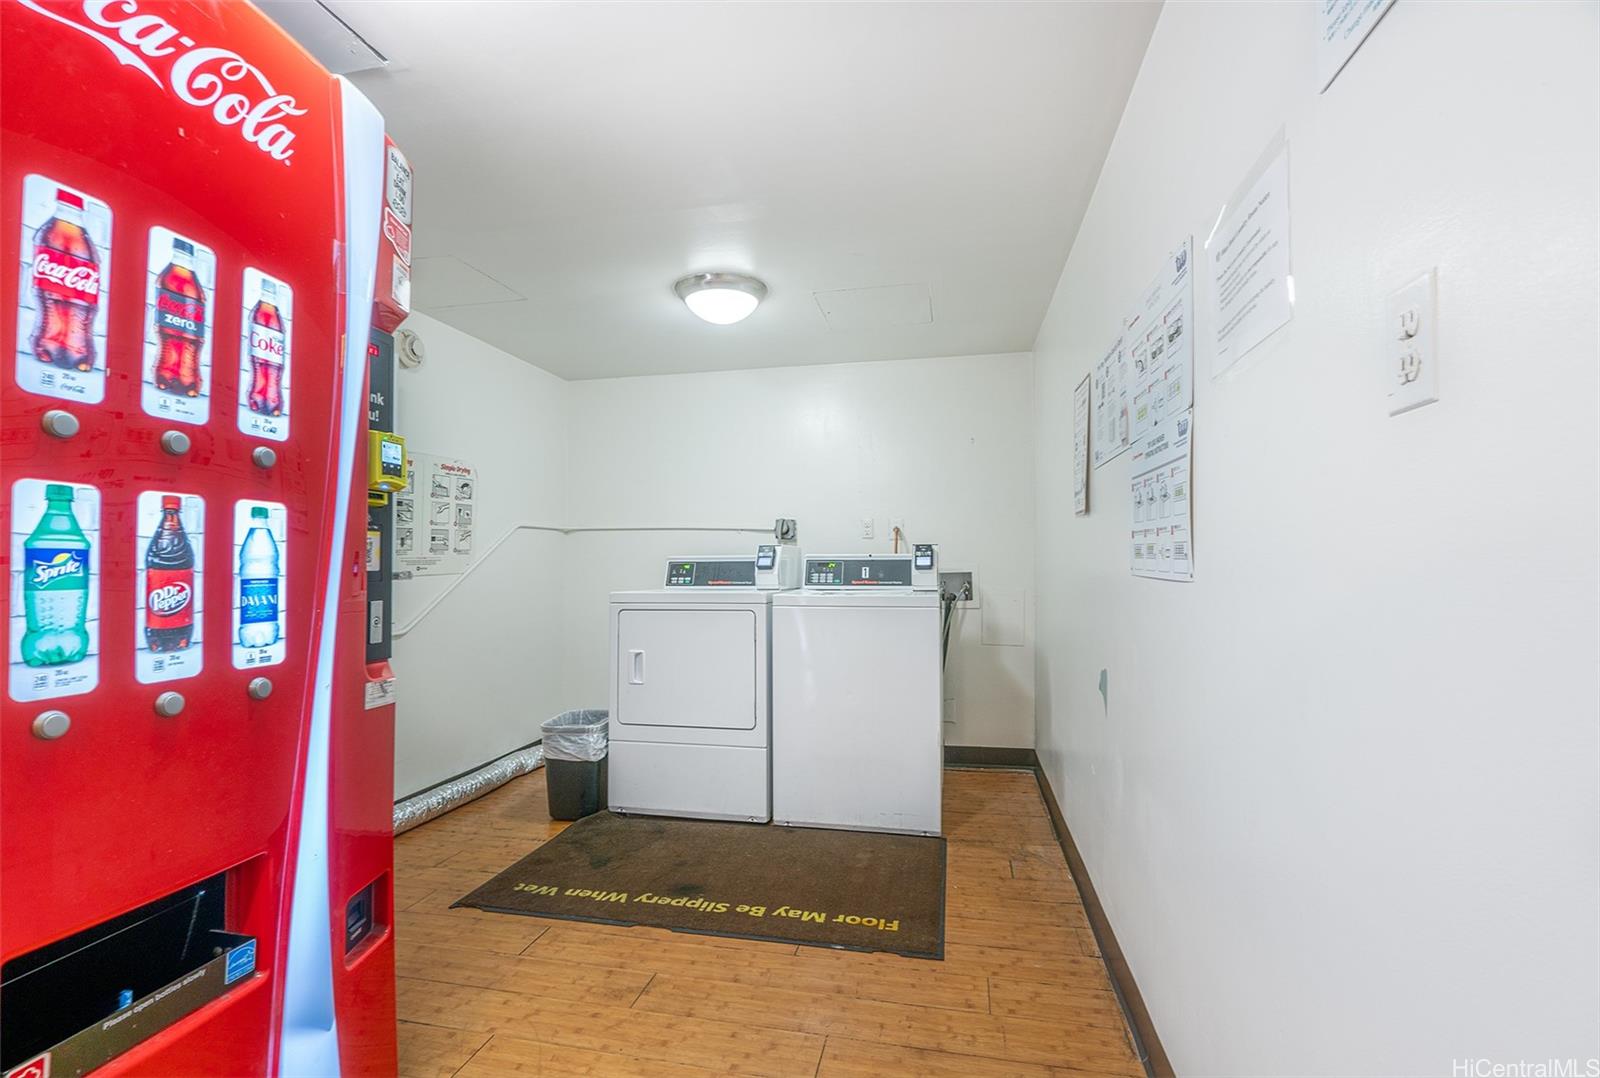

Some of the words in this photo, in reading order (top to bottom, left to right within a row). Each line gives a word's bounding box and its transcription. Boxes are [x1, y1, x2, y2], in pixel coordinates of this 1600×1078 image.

[83, 0, 308, 166] ca-Cola
[250, 331, 284, 356] Coke
[33, 559, 80, 583] Sprite
[152, 589, 188, 611] Pepper
[163, 586, 181, 598] Dr
[513, 882, 558, 897] Wet
[564, 887, 628, 904] When
[633, 893, 731, 913] Slippery
[735, 904, 767, 917] Be
[772, 905, 827, 923] May
[832, 915, 900, 932] Floor
